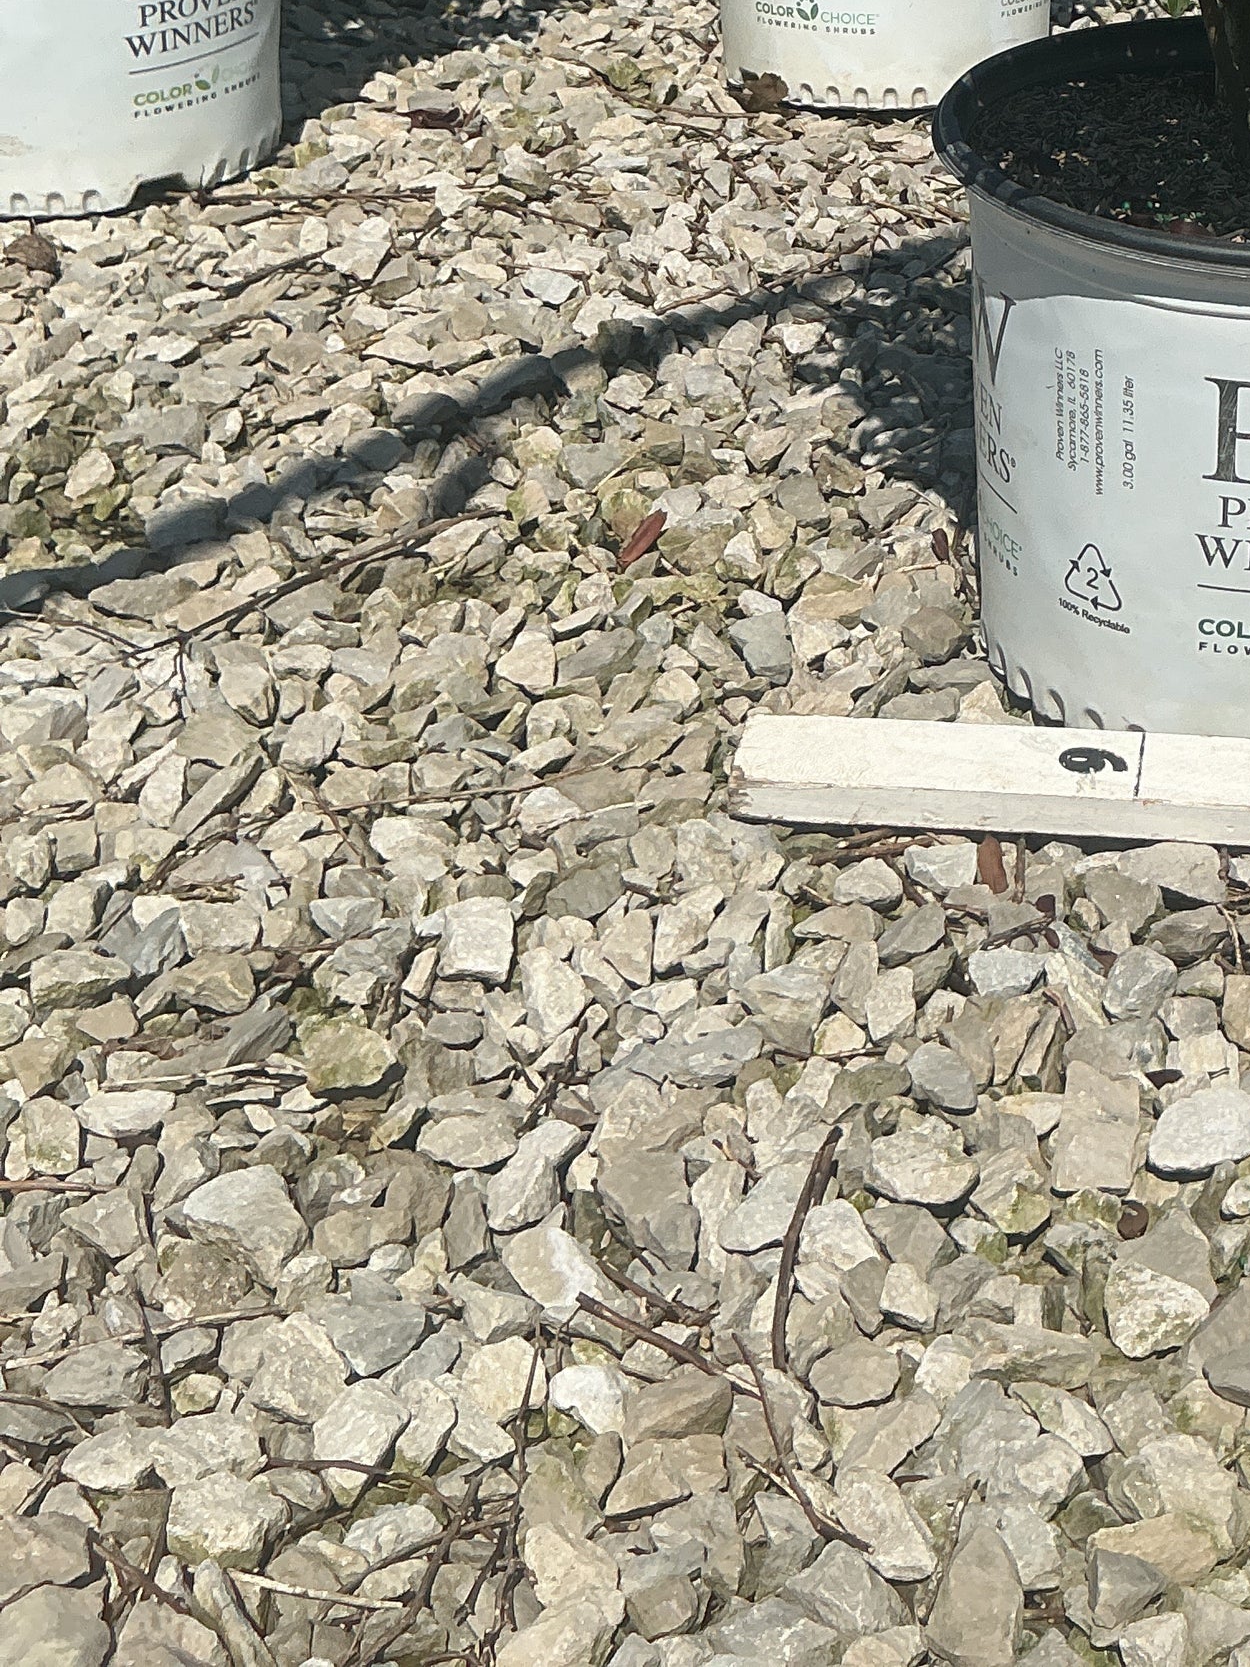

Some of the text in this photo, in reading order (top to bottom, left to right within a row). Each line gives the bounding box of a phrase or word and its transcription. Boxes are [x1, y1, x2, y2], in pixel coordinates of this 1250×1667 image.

[755, 1, 795, 18] COLOR
[133, 83, 194, 108] COLOR
[1066, 350, 1077, 389] 60178
[1054, 347, 1065, 462] Proven Winners LLC
[1079, 368, 1090, 464] 1-877-865-5818
[1094, 348, 1106, 496] www.provenwinners.com
[1122, 398, 1135, 434] 11.35
[1067, 408, 1077, 472] Sycamore,
[1122, 439, 1137, 462] gal
[1122, 461, 1135, 490] 3.00
[1085, 566, 1100, 591] 2
[1058, 597, 1131, 635] 100% Recyclable
[1058, 746, 1129, 774] 6
